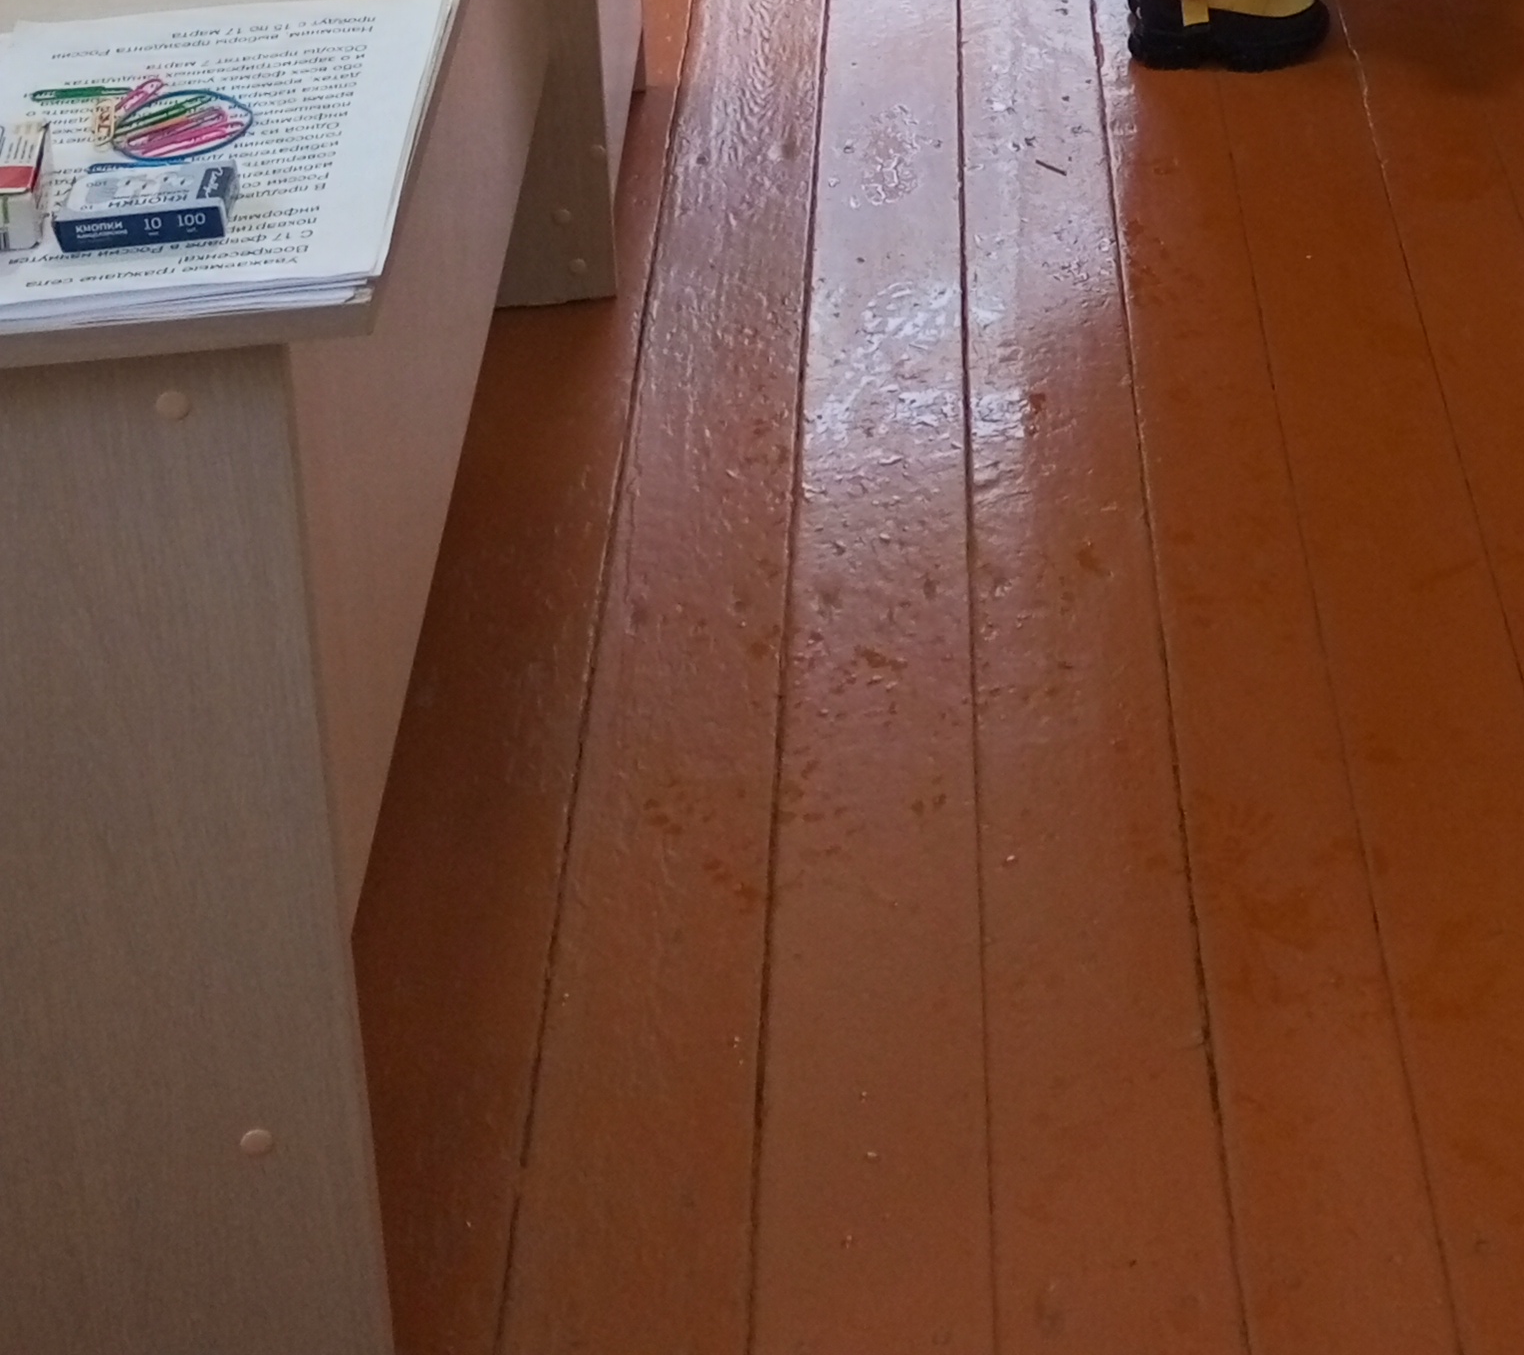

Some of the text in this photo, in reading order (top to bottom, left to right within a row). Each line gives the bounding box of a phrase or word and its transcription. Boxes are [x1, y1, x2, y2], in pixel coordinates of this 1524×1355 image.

[225, 27, 244, 36] 17
[251, 111, 349, 128] информиро
[284, 122, 340, 133] Одной
[236, 161, 334, 179] избирател
[143, 217, 163, 231] 10
[177, 212, 206, 228] 100
[227, 205, 320, 222] информир
[227, 217, 317, 234] поквартир
[272, 232, 291, 242] 17
[96, 245, 164, 258] России
[182, 256, 298, 272] Уважаемые
[79, 267, 175, 284] граждане
